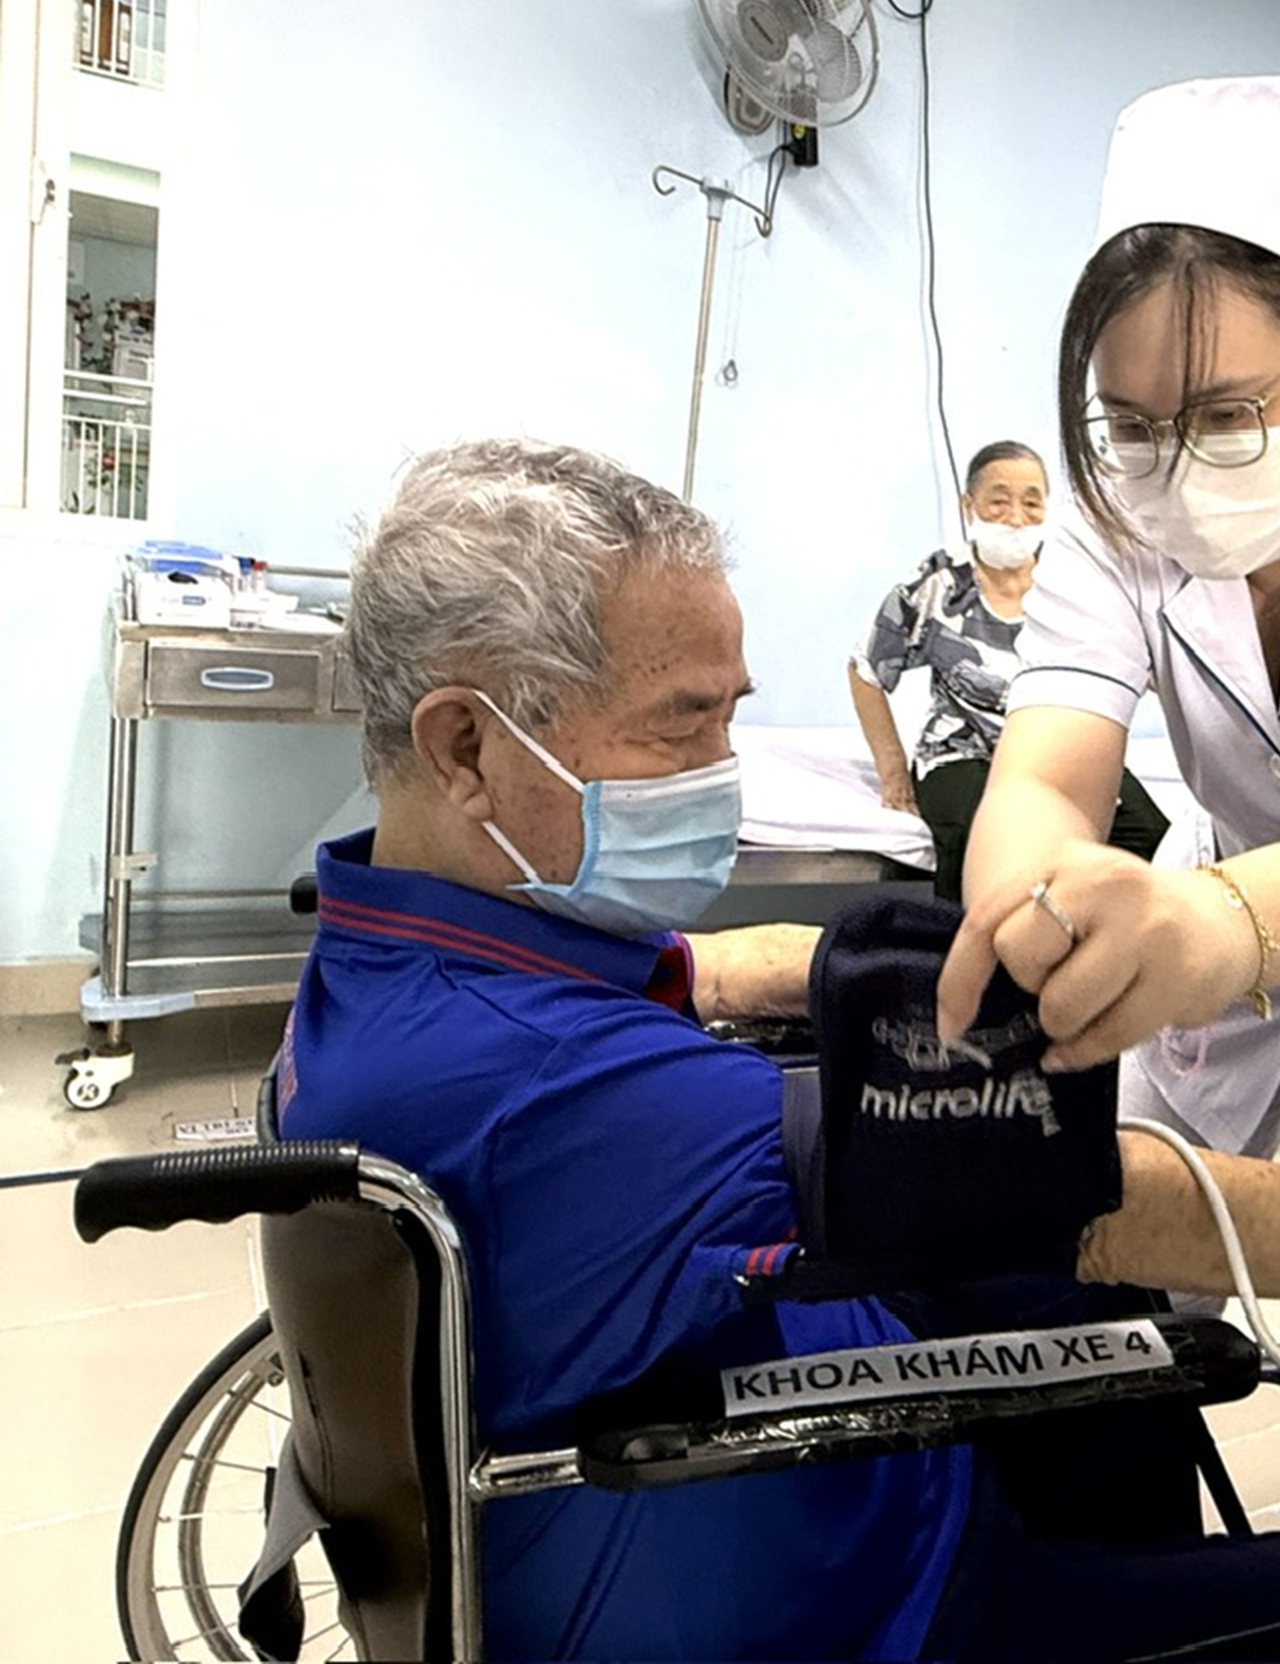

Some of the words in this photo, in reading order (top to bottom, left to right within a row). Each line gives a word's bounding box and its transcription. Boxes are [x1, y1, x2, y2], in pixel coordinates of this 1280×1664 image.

[733, 1357, 884, 1401] KHOA
[896, 1340, 1043, 1382] KHÁM
[1053, 1331, 1115, 1367] XE
[1125, 1329, 1153, 1356] 4
